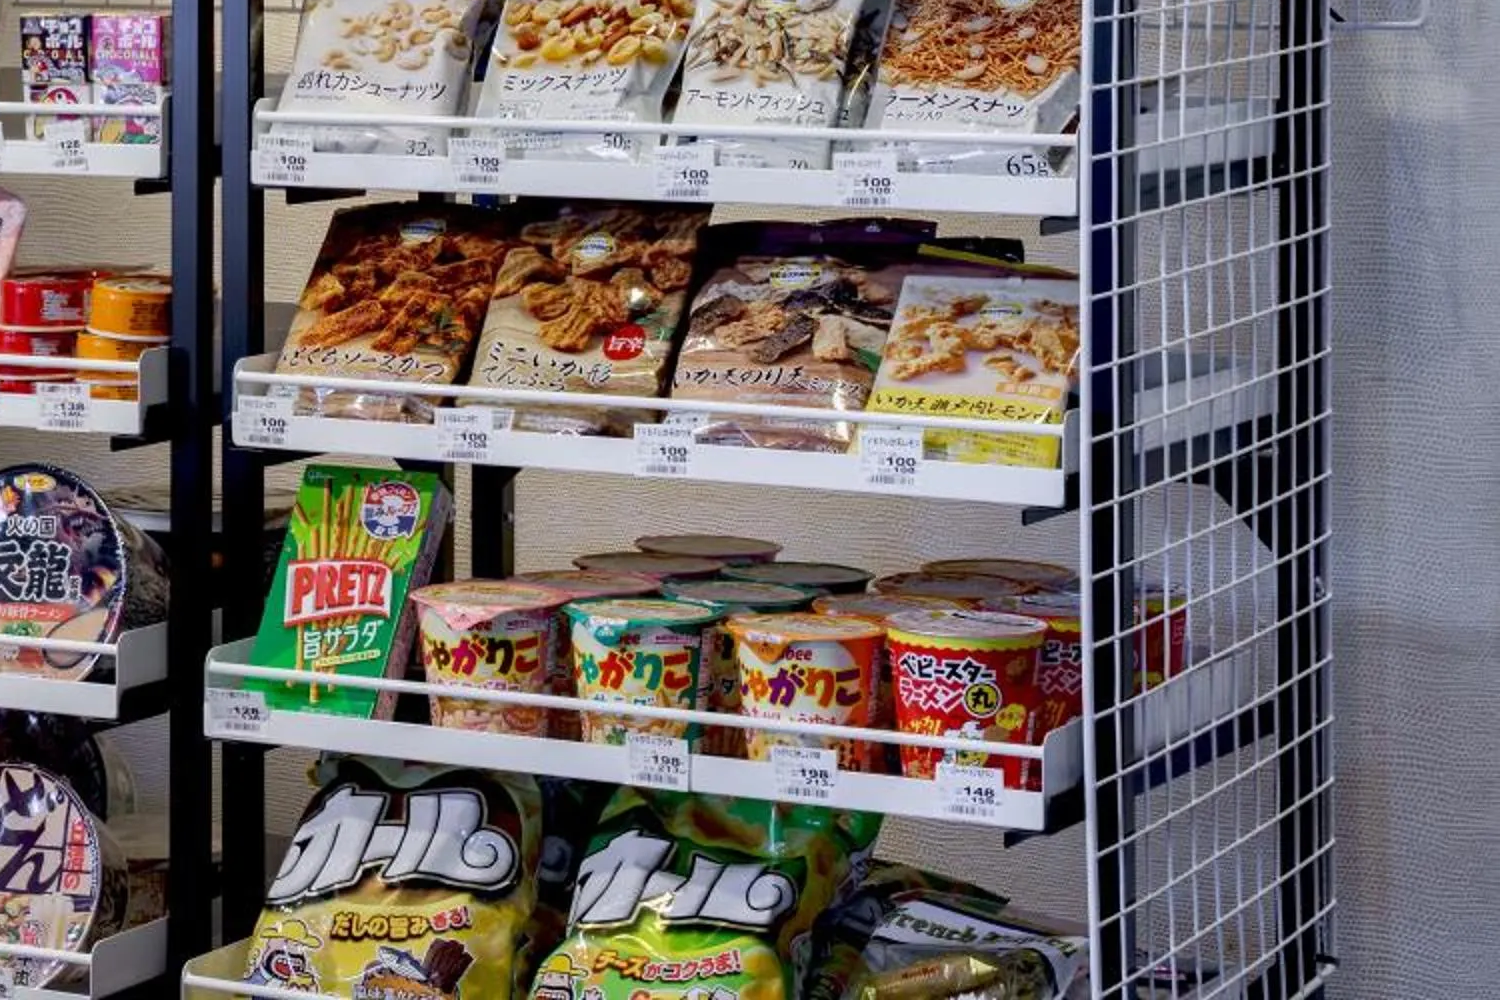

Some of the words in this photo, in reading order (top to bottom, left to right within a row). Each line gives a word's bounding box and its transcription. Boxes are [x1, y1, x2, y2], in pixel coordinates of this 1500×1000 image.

[503, 69, 628, 92] ミックスナッツ
[686, 89, 825, 117] アーモンドフィッシュ
[279, 156, 307, 165] 100
[472, 157, 500, 167] 100
[1006, 153, 1049, 177] 65g
[681, 170, 710, 180] 100
[862, 177, 891, 187] 100
[260, 417, 286, 427] 100
[460, 433, 487, 442] 100
[660, 446, 688, 457] 100
[886, 456, 917, 467] 100
[6, 515, 57, 538] 火の国
[290, 560, 388, 619] PRETZ
[302, 618, 386, 660] 旨サラダ
[900, 654, 998, 682] ベビースター
[971, 690, 996, 713] 丸
[652, 755, 681, 766] 198
[962, 787, 995, 799] 148
[266, 783, 519, 904] カール
[567, 828, 799, 936] カール
[593, 949, 742, 981] チーズがコクうま!
